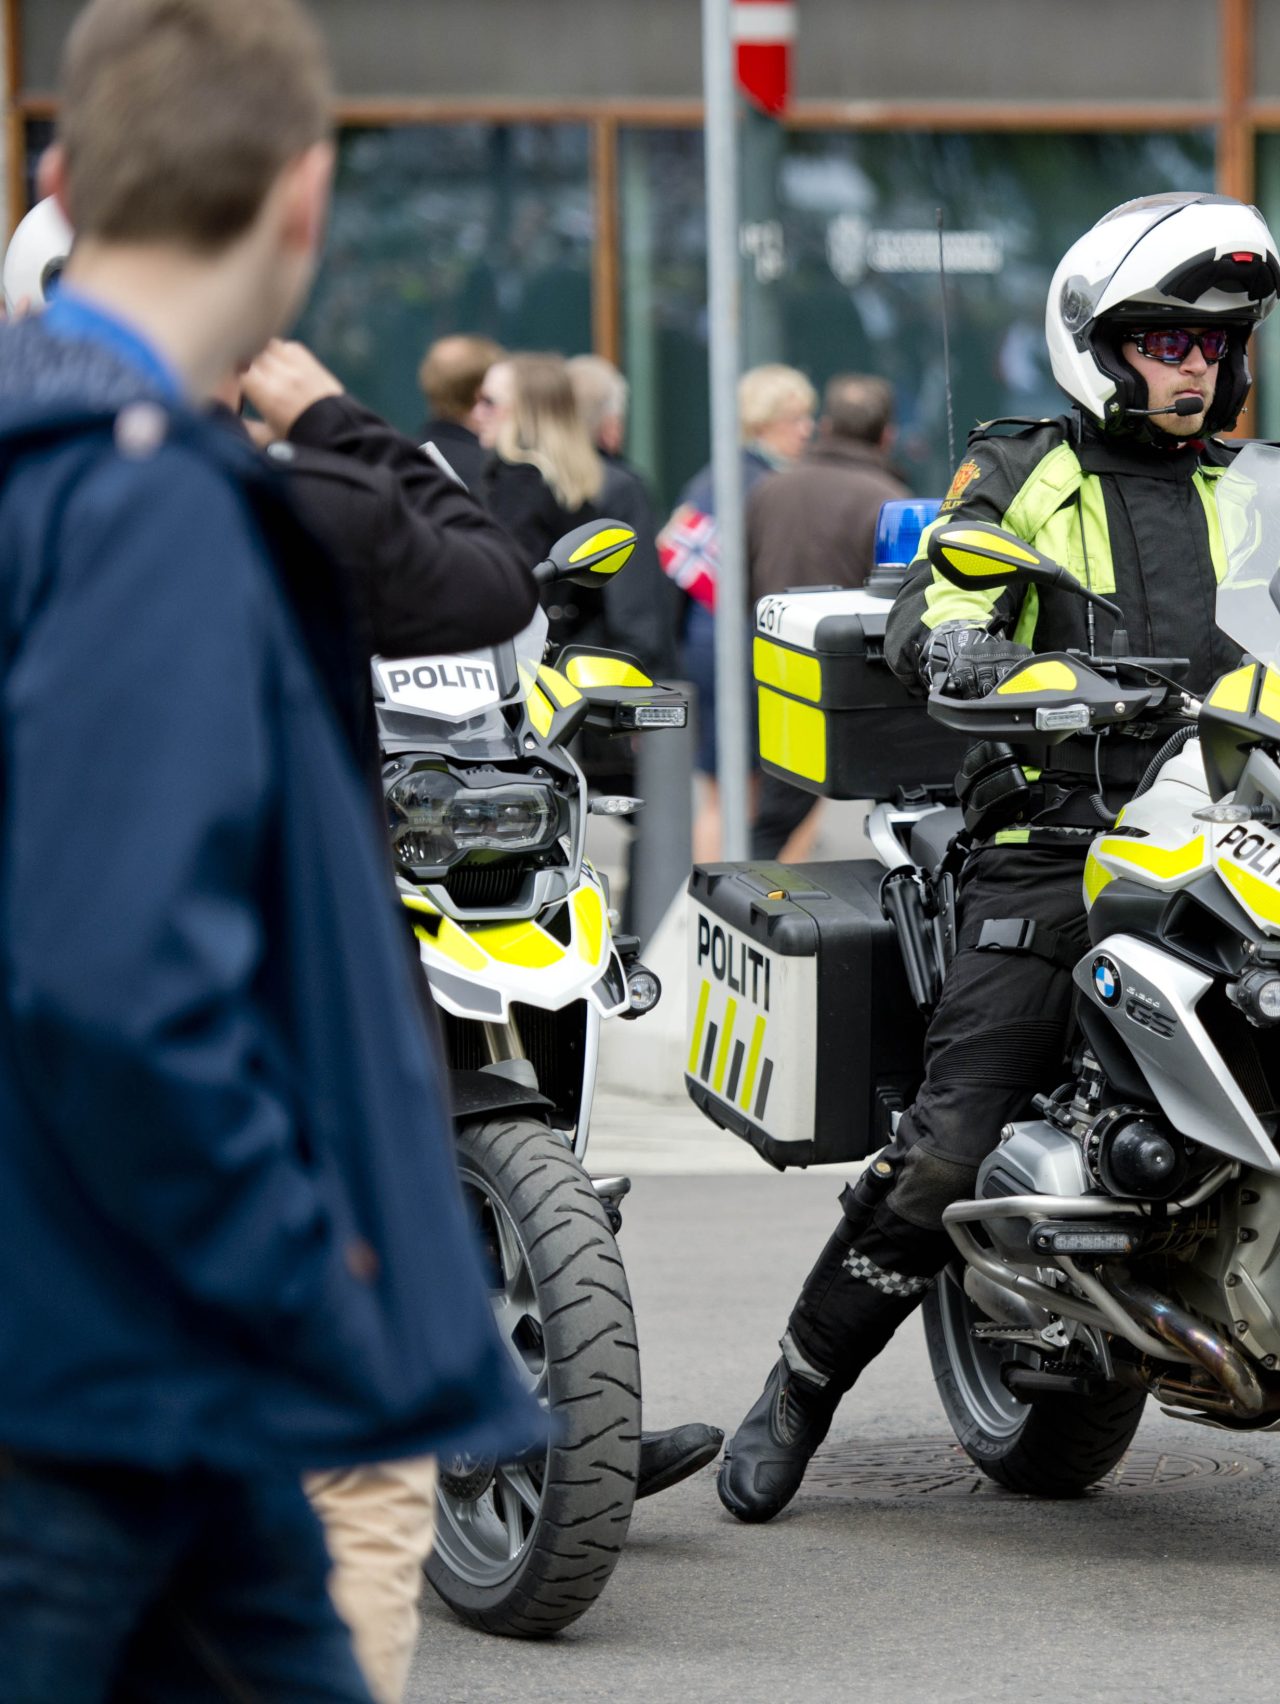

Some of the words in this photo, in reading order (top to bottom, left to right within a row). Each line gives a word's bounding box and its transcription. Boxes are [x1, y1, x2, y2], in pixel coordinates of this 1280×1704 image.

[759, 598, 791, 634] 261
[388, 664, 495, 693] POLITI
[697, 913, 770, 1013] POLITI
